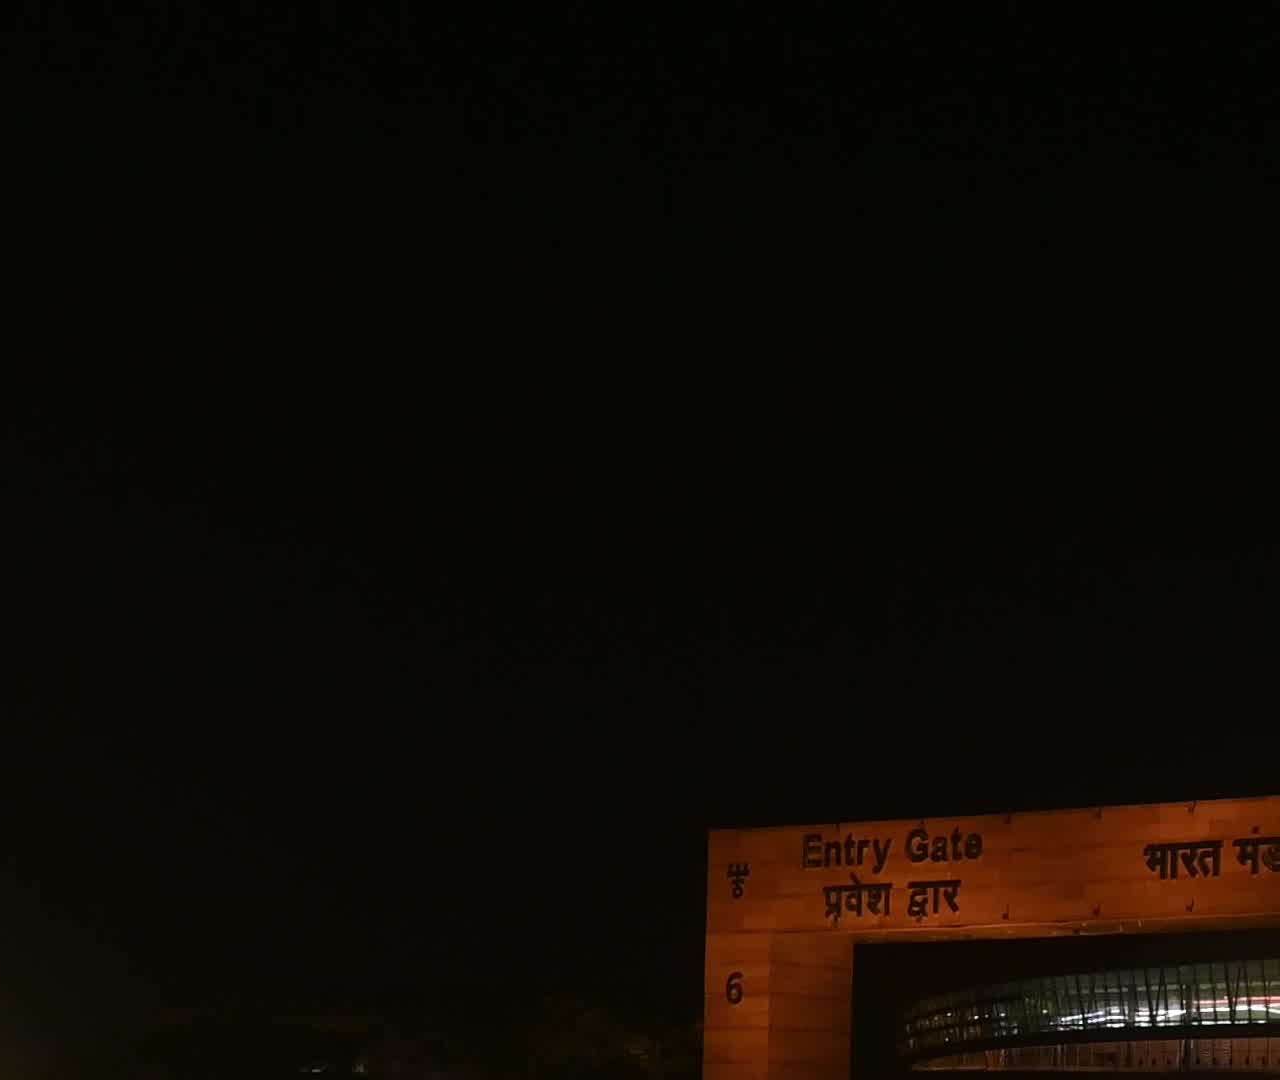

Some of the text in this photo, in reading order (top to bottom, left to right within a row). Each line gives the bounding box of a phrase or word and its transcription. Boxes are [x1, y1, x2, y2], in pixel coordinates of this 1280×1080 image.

[802, 826, 984, 874] Entry Gate
[1144, 840, 1224, 880] भारत
[824, 872, 961, 923] प्रवेश द्वार
[726, 971, 744, 1005] 6
